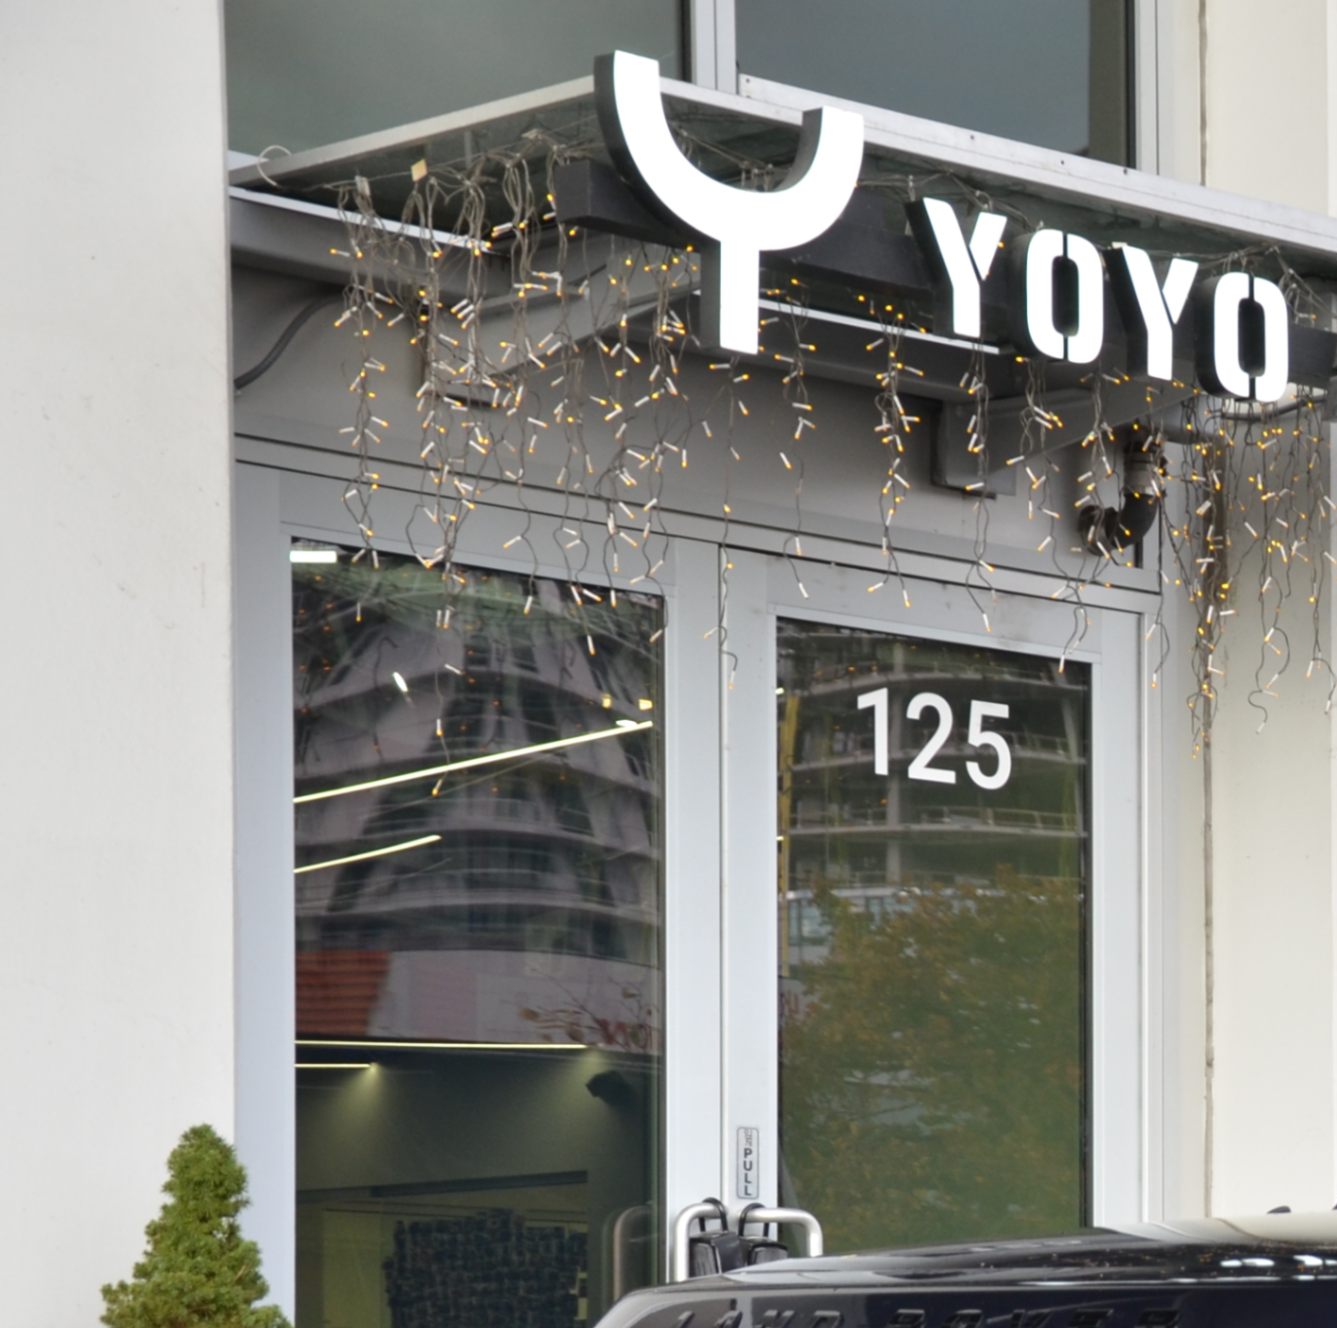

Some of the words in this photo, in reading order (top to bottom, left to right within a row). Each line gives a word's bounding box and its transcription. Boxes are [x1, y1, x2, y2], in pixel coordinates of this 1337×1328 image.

[922, 197, 1290, 404] YOYO
[855, 687, 1012, 791] 125
[743, 1147, 753, 1196] PULL
